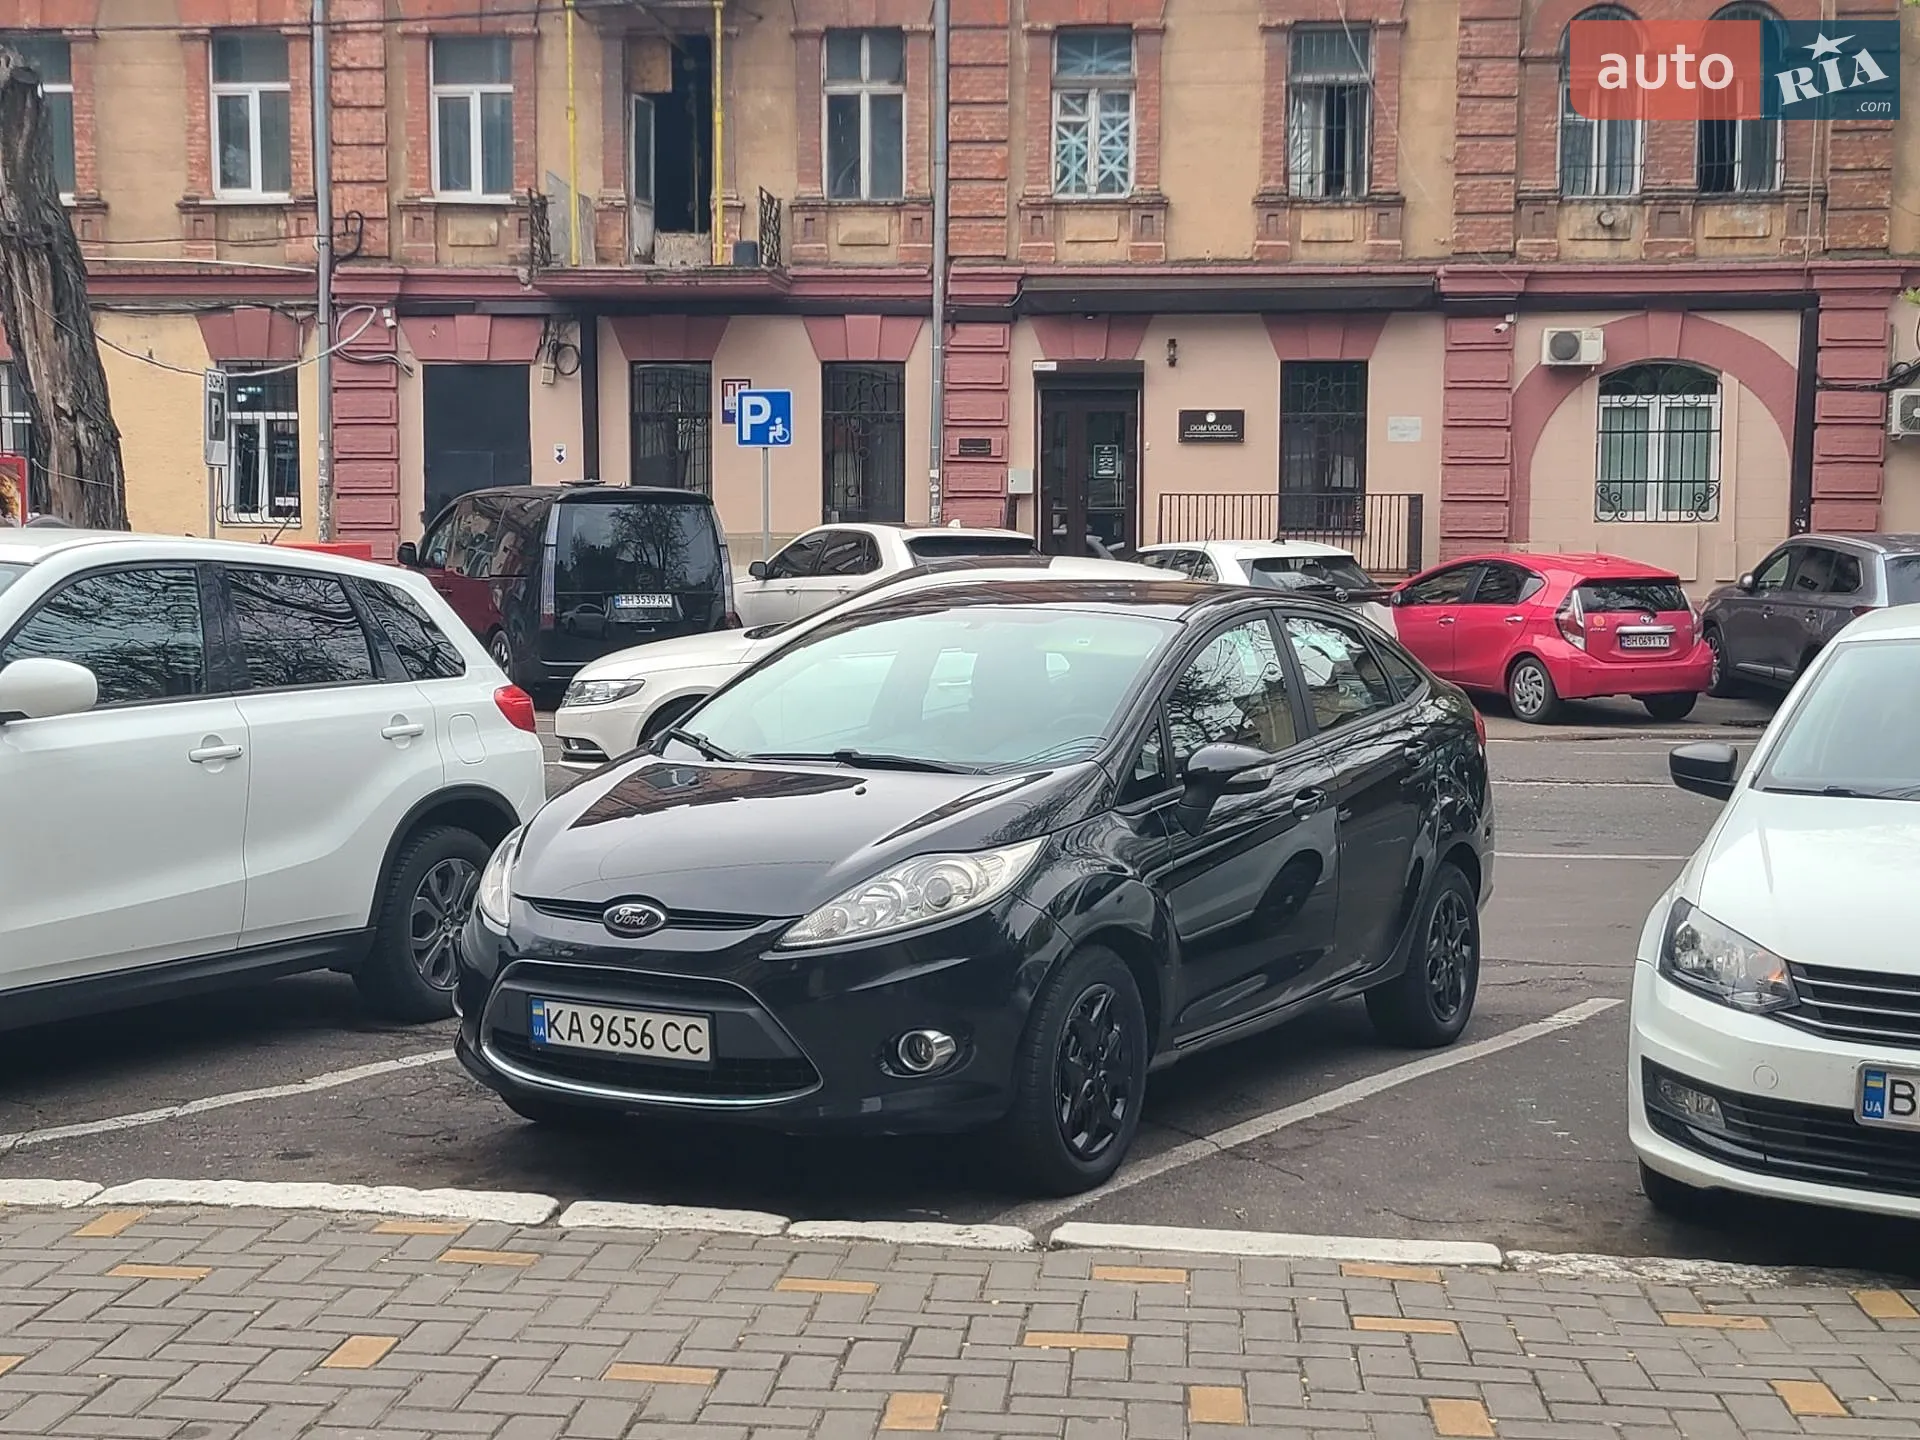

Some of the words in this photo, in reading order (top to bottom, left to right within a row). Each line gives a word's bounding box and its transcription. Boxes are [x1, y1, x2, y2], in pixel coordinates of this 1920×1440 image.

[211, 397, 222, 436] P
[742, 396, 771, 441] P
[657, 595, 671, 605] AK
[614, 906, 650, 926] Ford
[533, 1027, 545, 1037] UA
[546, 1007, 585, 1043] KA
[590, 1014, 655, 1050] 9656
[661, 1021, 704, 1055] CC
[1864, 1100, 1882, 1113] UA
